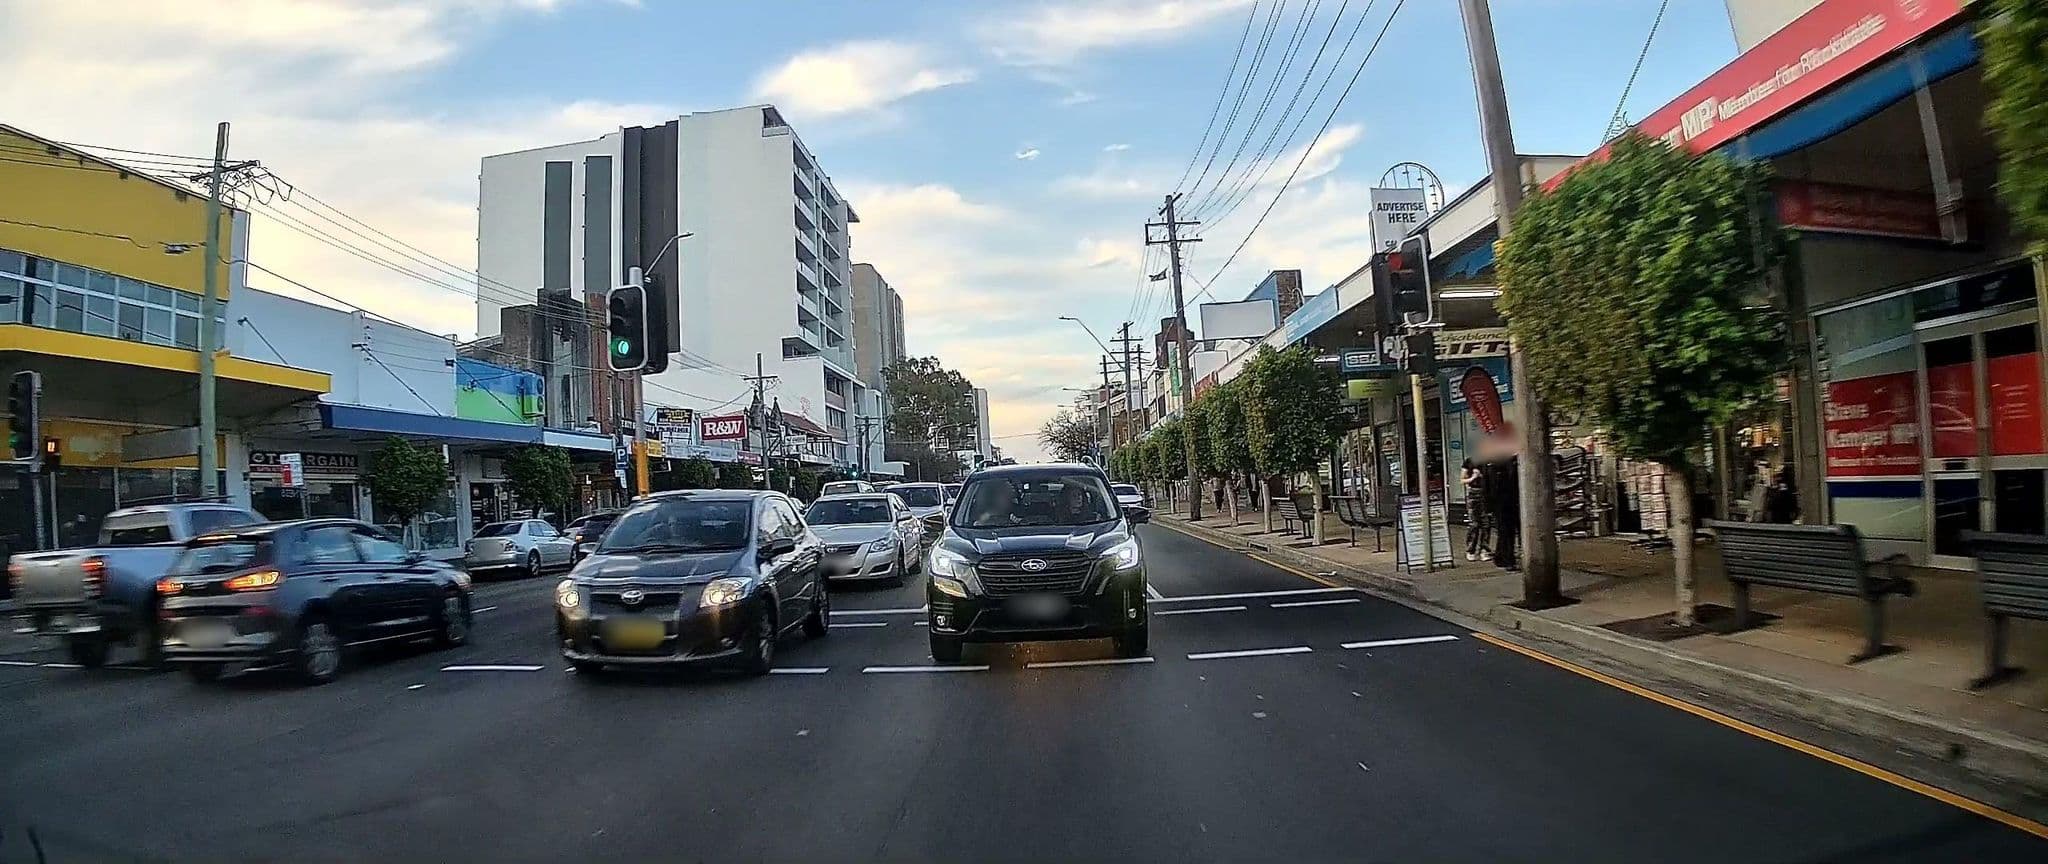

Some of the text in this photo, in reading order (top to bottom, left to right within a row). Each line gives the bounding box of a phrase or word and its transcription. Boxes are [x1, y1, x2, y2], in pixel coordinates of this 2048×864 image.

[1377, 202, 1424, 211] ADVERTISE
[1388, 213, 1416, 223] HERE
[1437, 331, 1507, 342] asablanc
[704, 421, 742, 436] R&W
[617, 449, 626, 460] P
